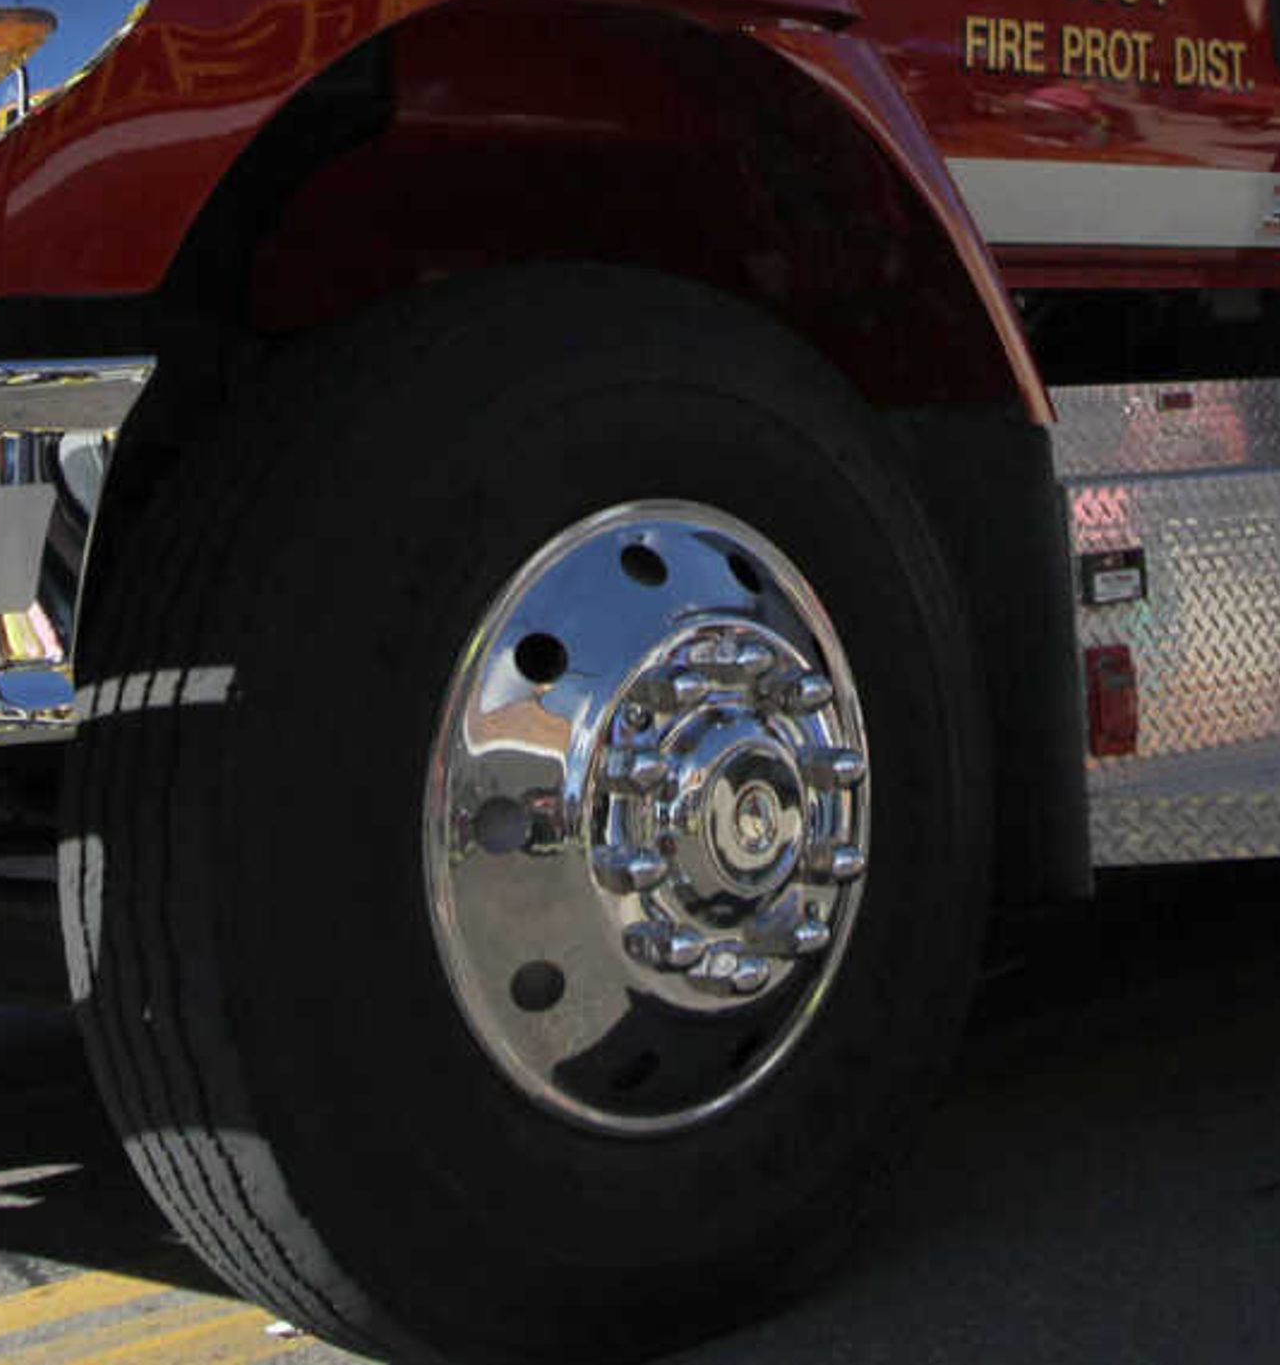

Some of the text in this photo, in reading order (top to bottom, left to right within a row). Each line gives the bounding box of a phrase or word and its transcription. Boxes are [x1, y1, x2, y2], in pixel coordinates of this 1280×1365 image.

[965, 16, 1255, 90] FIRE PROT. DIST.
